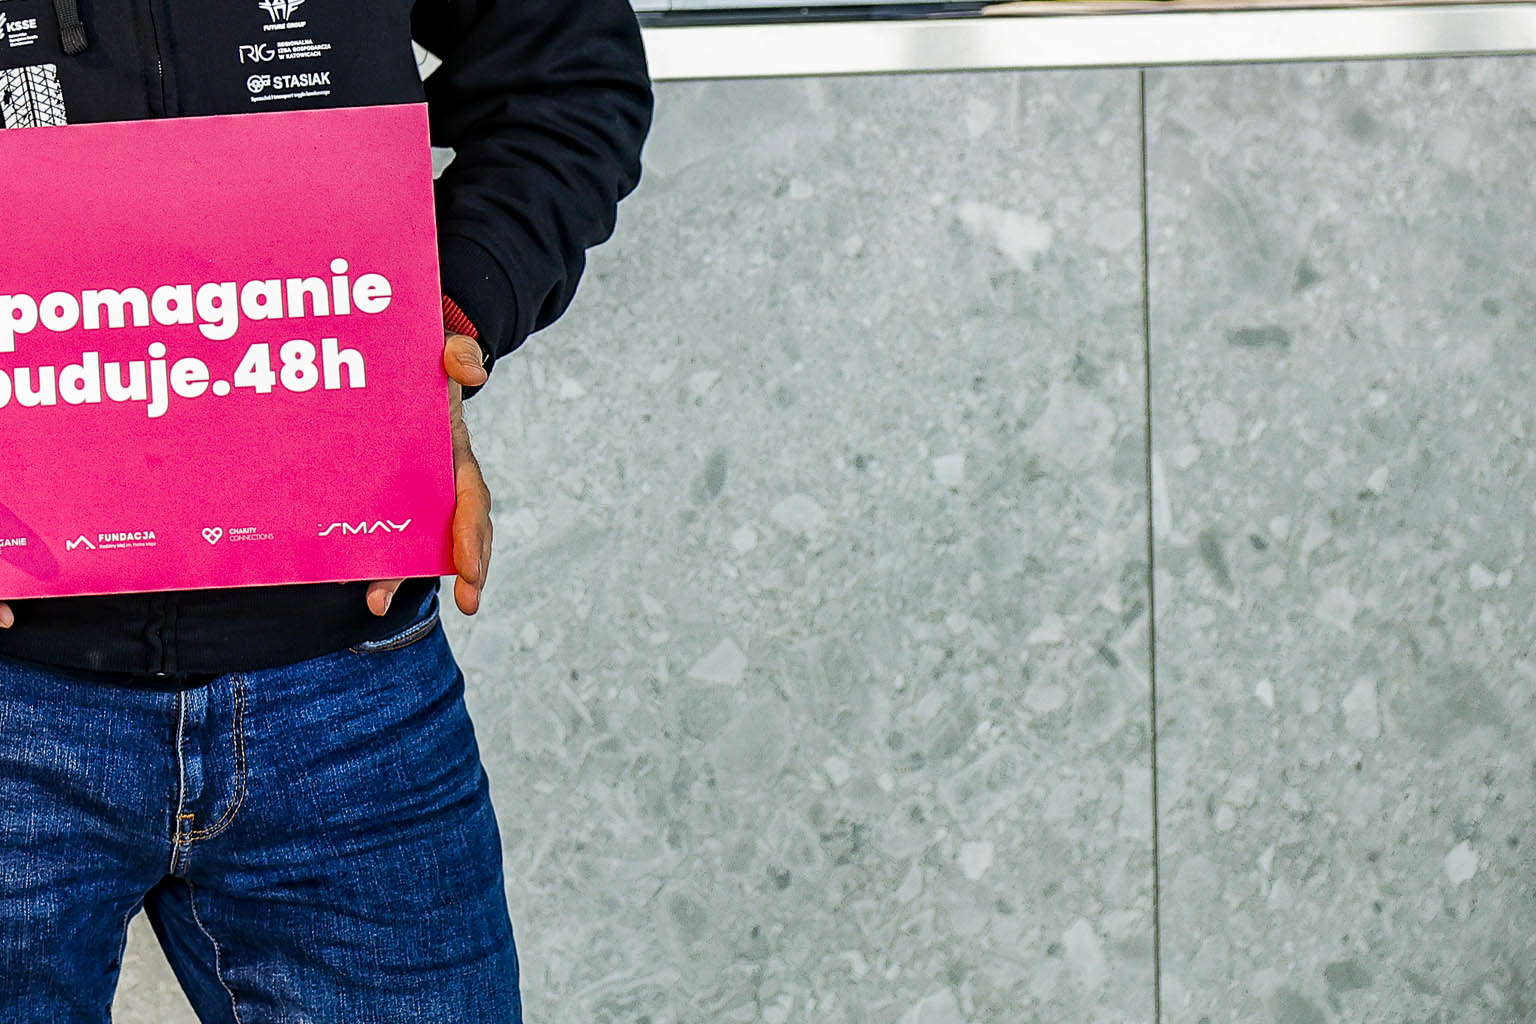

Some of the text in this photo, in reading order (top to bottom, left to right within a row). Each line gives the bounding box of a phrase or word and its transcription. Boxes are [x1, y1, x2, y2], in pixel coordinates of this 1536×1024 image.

[6, 18, 38, 32] KSSE
[239, 43, 276, 64] RIG
[272, 71, 331, 89] STASIAK
[98, 530, 156, 542] FUNDACJA
[229, 526, 257, 535] CHARITY
[229, 533, 274, 542] CONNECTIONS
